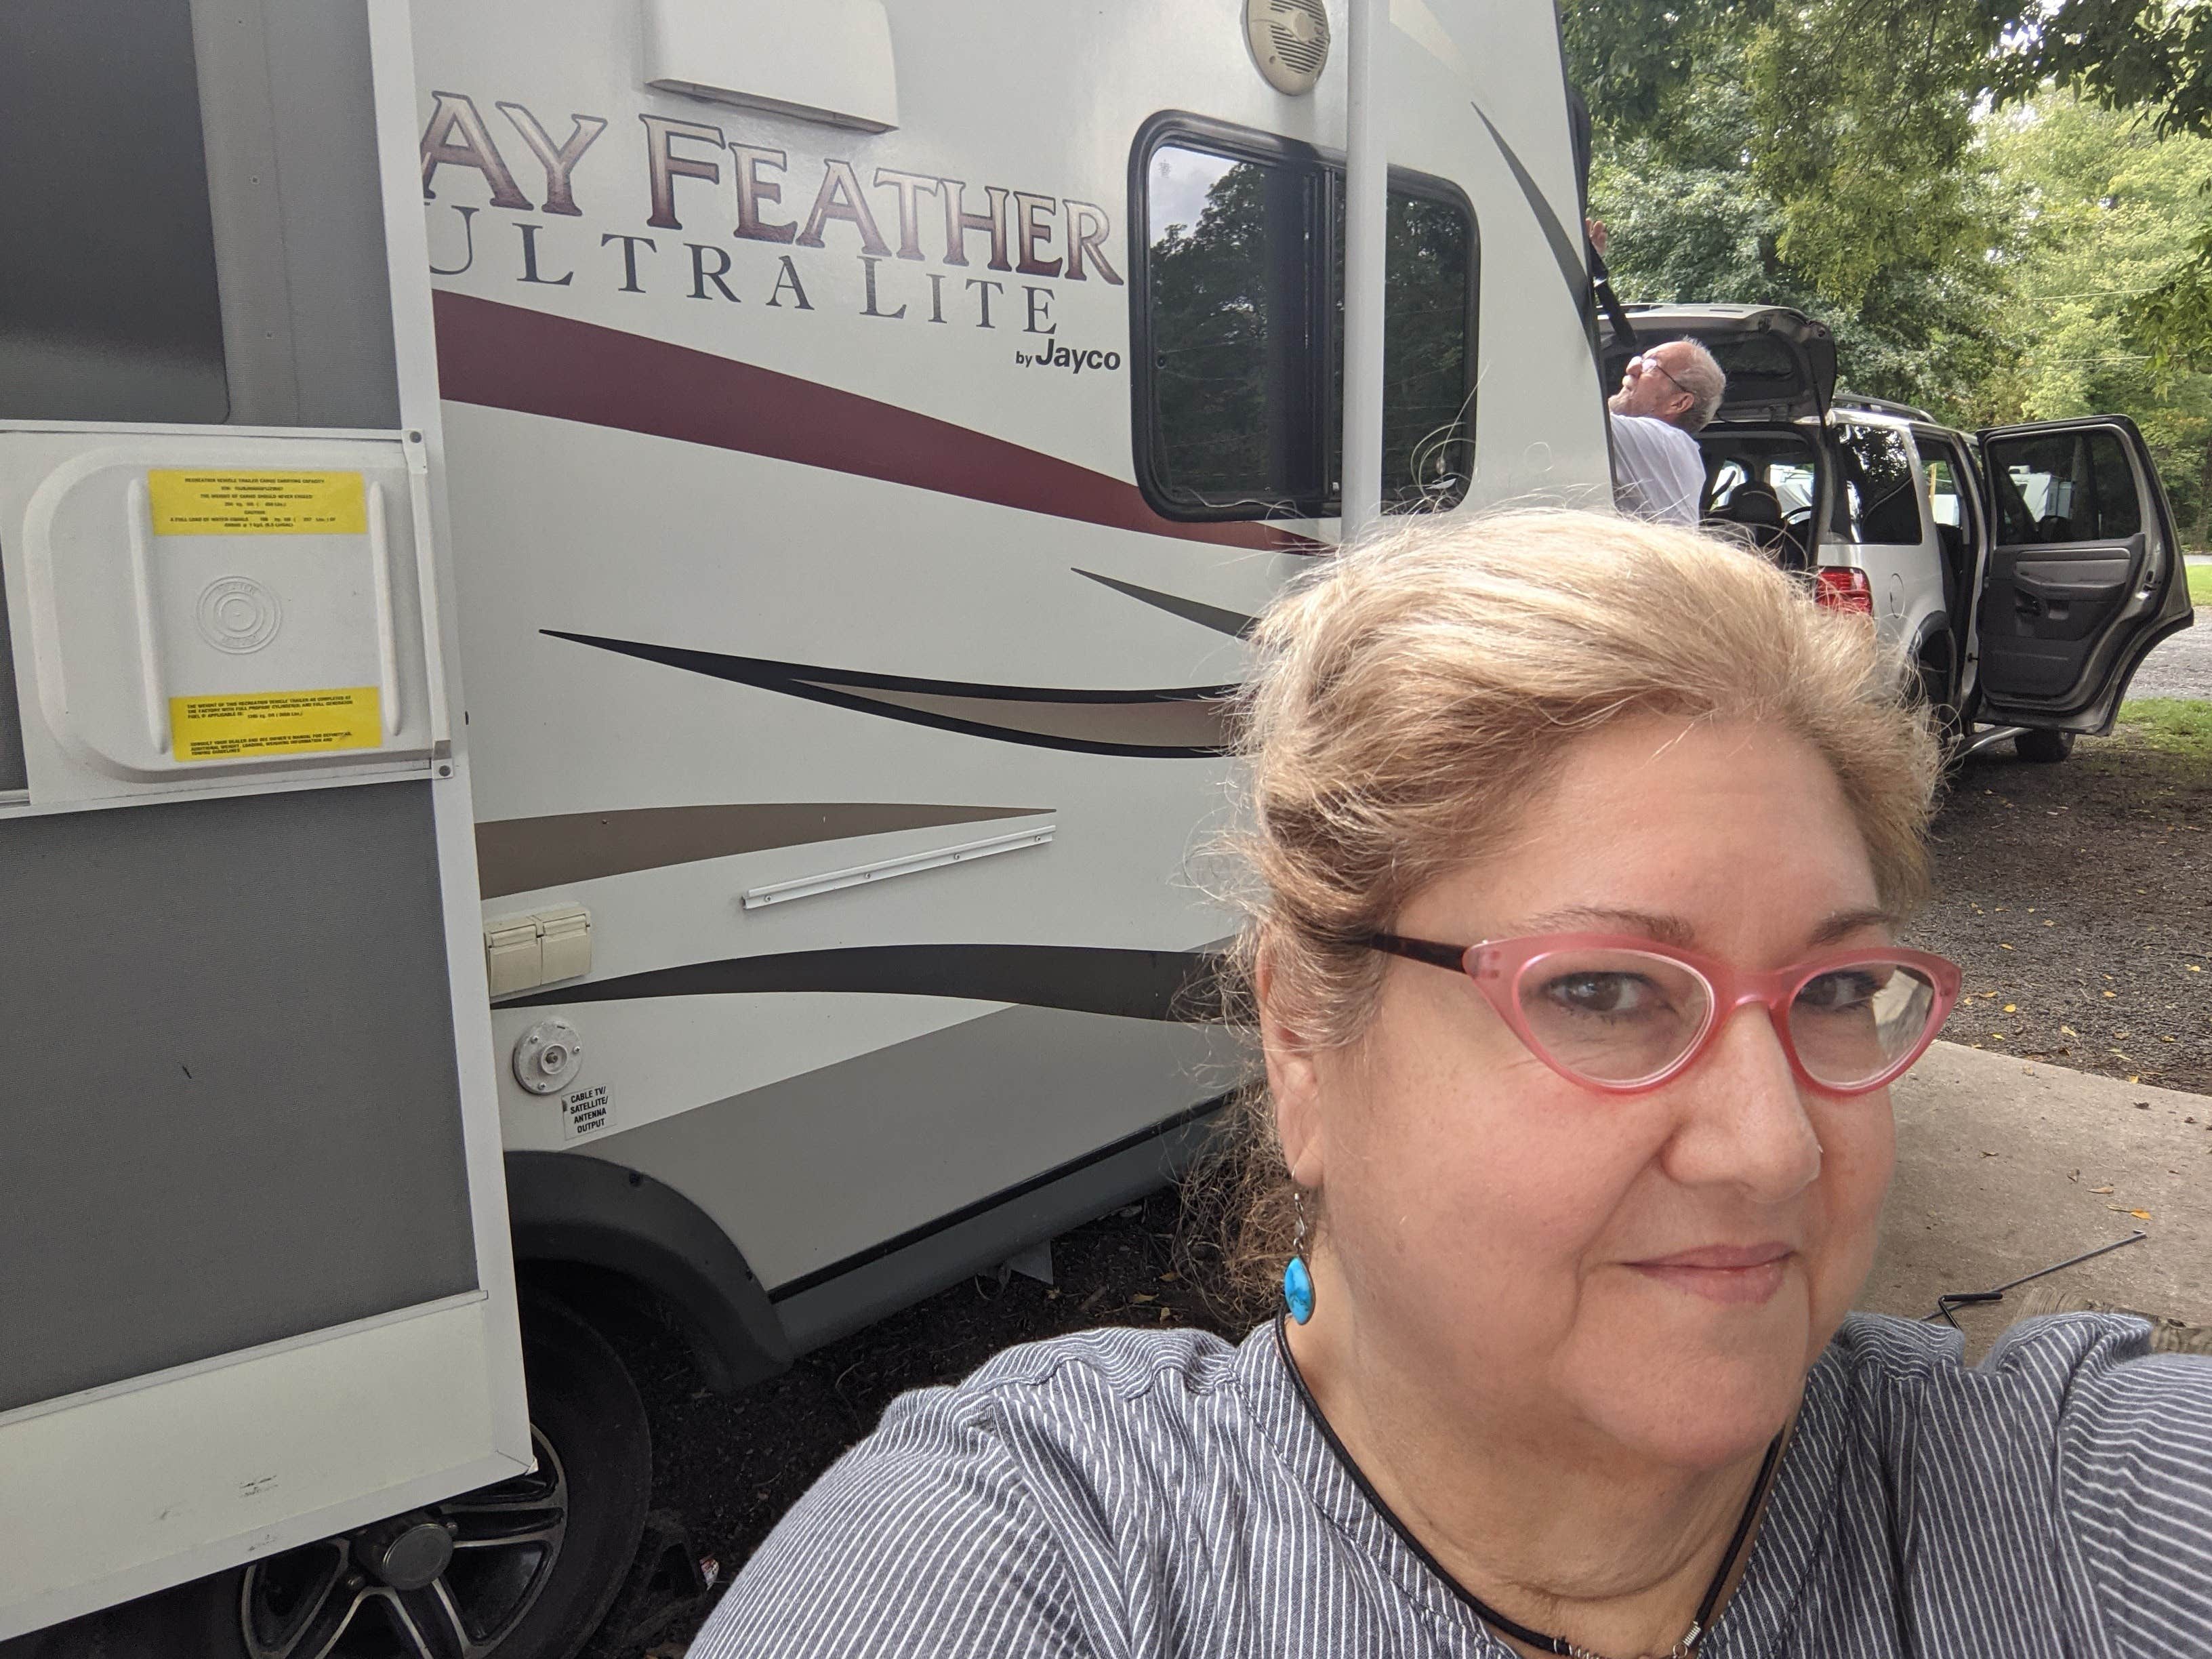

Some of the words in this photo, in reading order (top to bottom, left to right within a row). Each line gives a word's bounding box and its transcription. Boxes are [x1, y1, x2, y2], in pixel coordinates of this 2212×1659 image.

[638, 112, 1124, 286] FEATHER
[857, 255, 1057, 335] LITE
[1016, 350, 1033, 368] by
[1035, 339, 1121, 374] Jayco
[571, 1090, 593, 1103] CABLE
[595, 1086, 606, 1097] TV/
[570, 1096, 609, 1114] SATELLITE/
[574, 1107, 607, 1124] ANTENNA
[577, 1118, 605, 1134] OUTPUT
